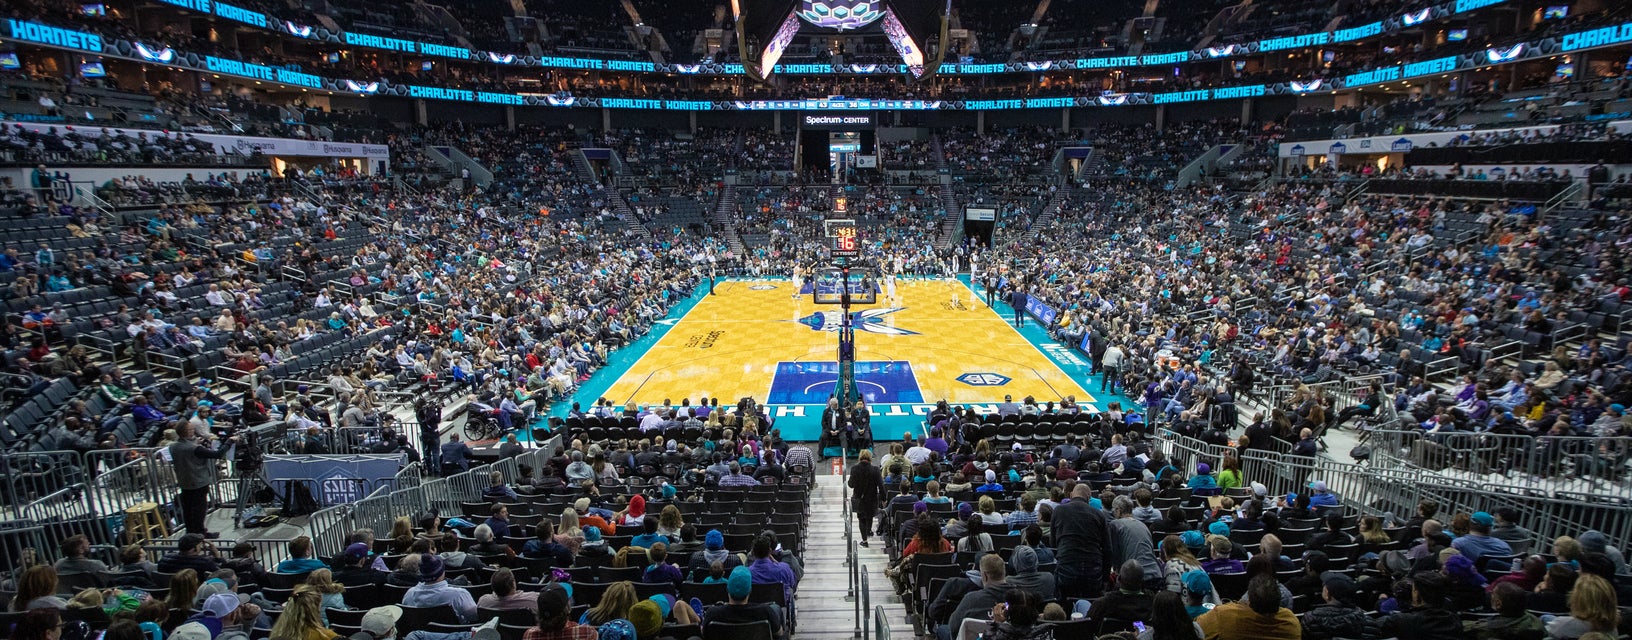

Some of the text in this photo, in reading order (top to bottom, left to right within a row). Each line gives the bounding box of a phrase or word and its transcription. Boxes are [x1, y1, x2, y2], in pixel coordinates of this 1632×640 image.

[214, 1, 267, 28] HORNETS
[8, 19, 102, 52] HORNETS
[344, 31, 470, 60] CHARLOTTE HORNETS
[1259, 21, 1383, 52] CHARLOTTE HORNETS
[541, 56, 655, 72] CHARLOTTE HORNETS
[785, 64, 832, 74] HORNETS
[960, 63, 1005, 74] HORNETS
[1077, 50, 1189, 69] CHARLOTTE HORNETS
[205, 55, 322, 89] CHARLOTTE HORNETS
[1345, 55, 1457, 88] CHARLOTTE HORNETS
[409, 85, 524, 105] CHARLOTTE HORNETS
[602, 97, 712, 111] CHARLOTTE HORNETS
[965, 97, 1074, 110] CHARLOTTE HORNETS
[1153, 84, 1265, 104] CHARLOTTE HORNETS
[806, 115, 840, 125] Spectrum
